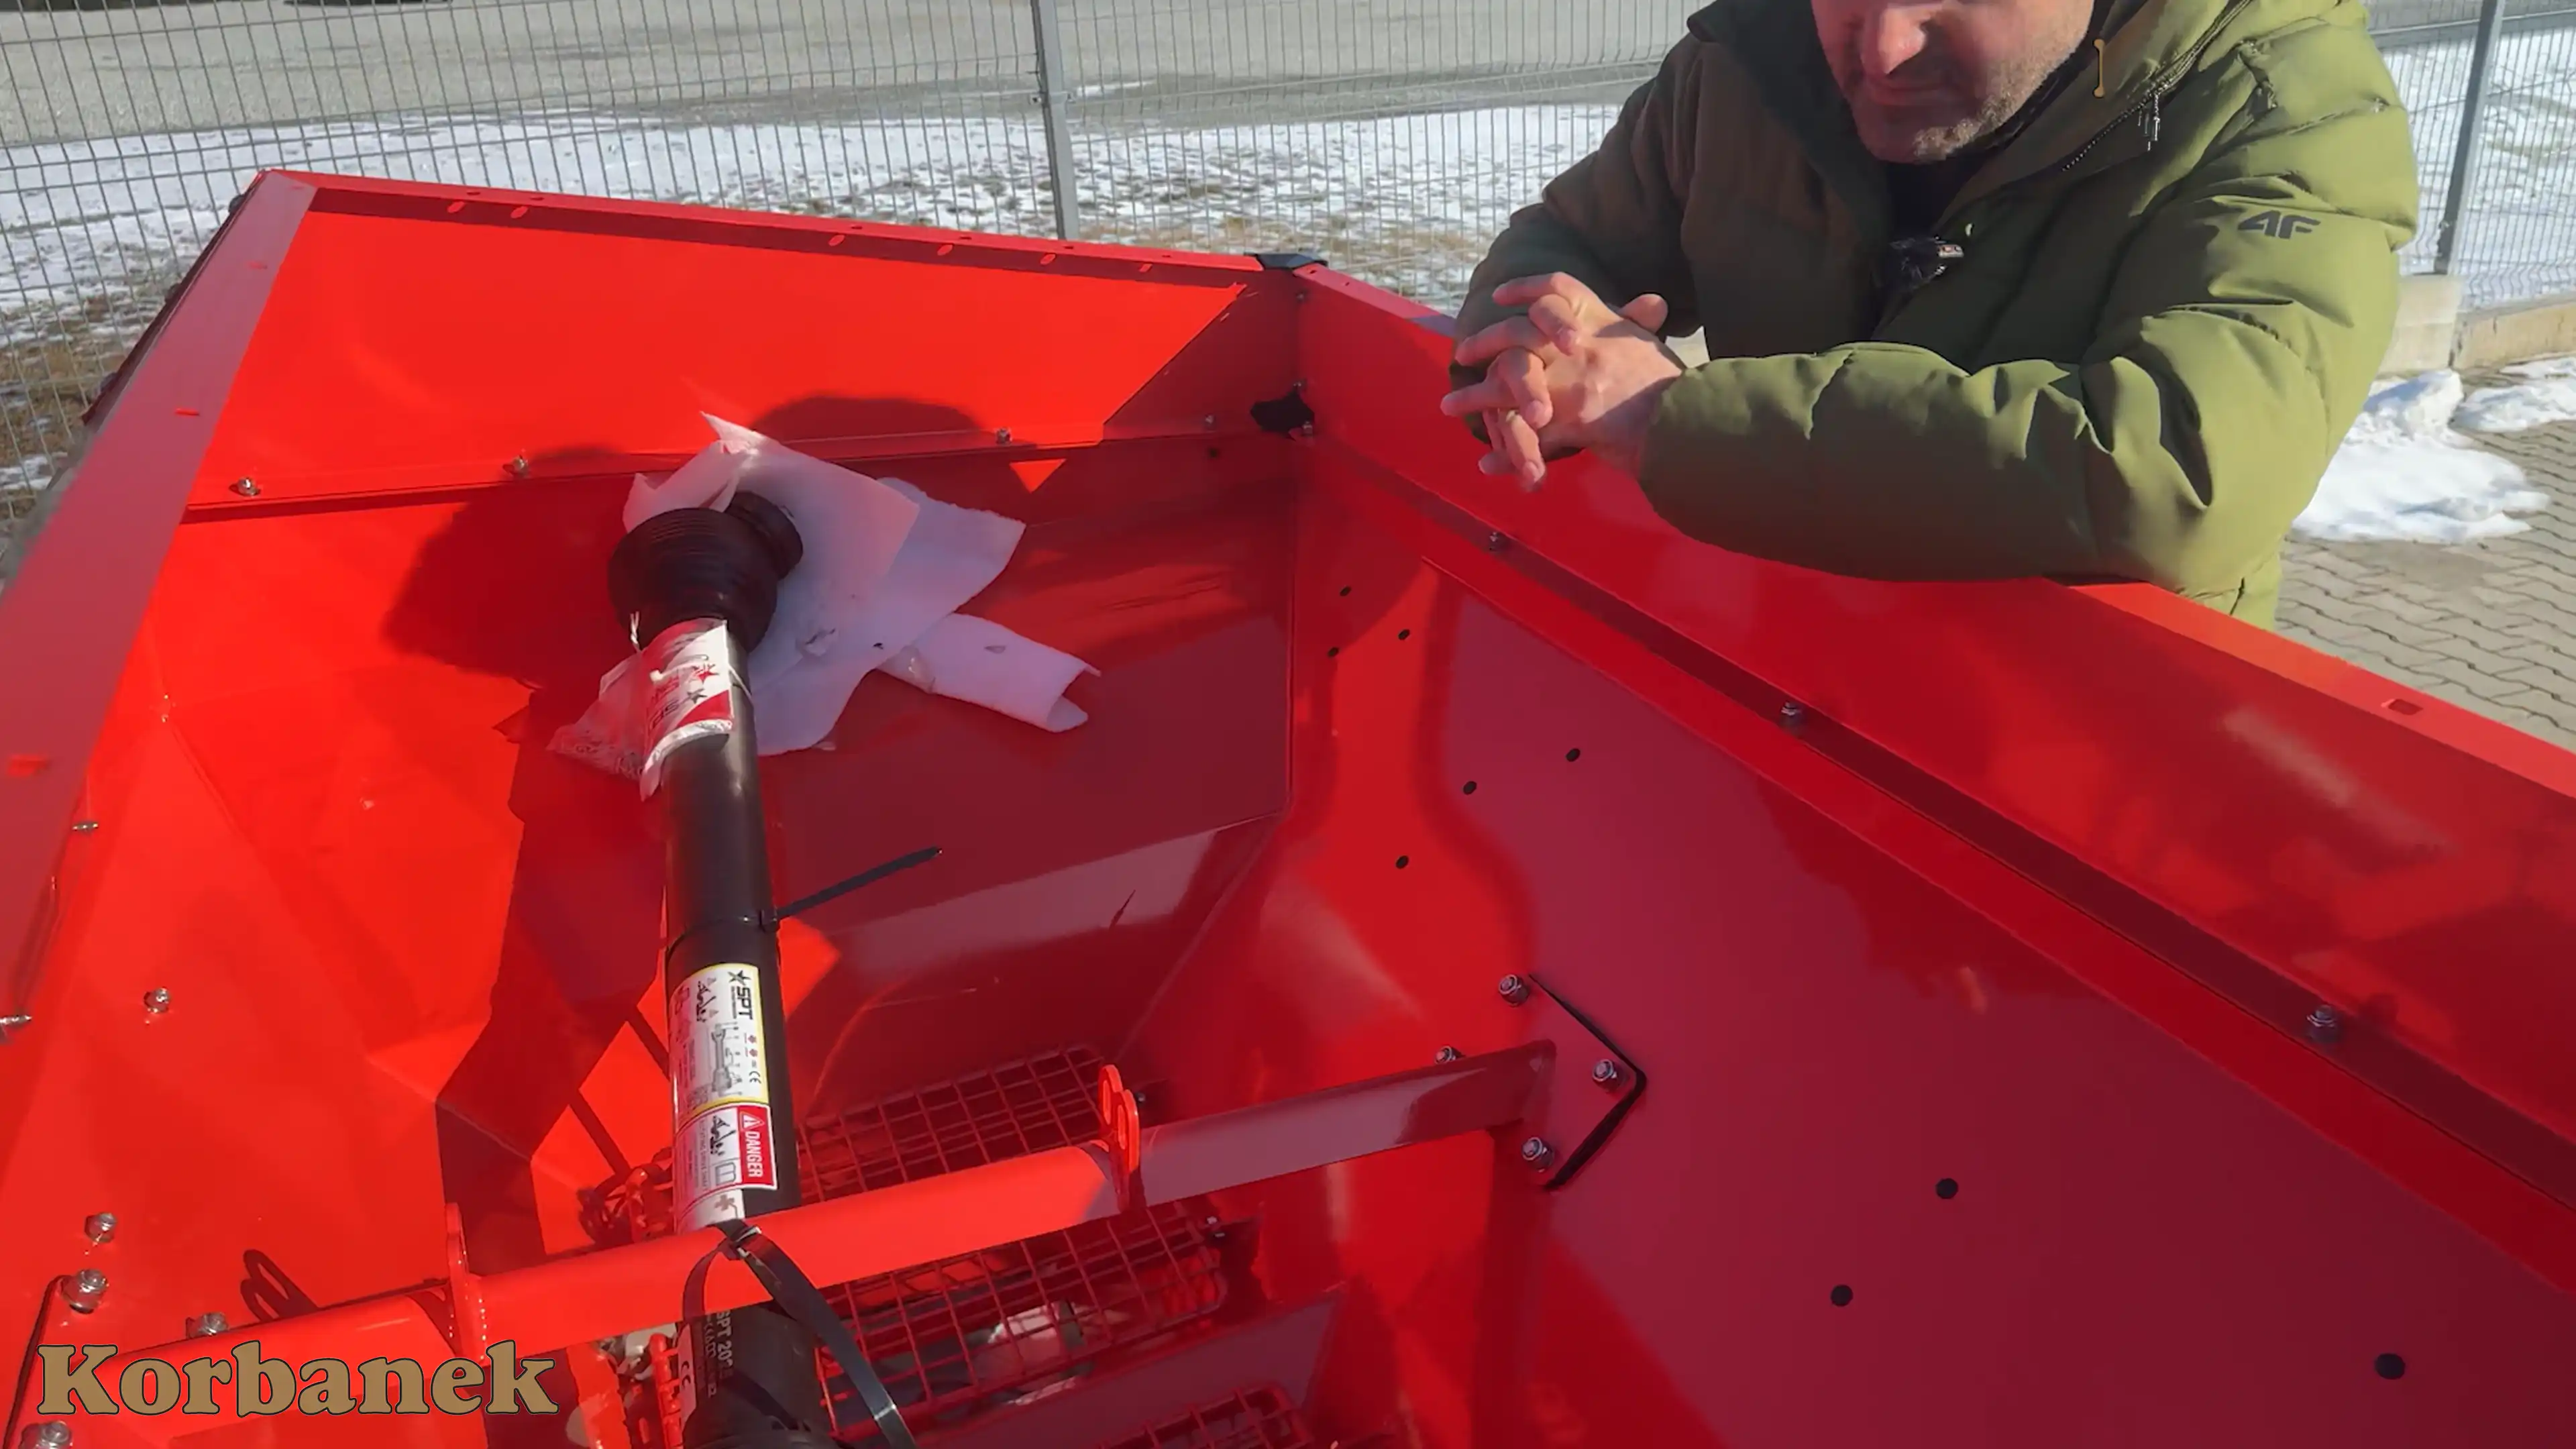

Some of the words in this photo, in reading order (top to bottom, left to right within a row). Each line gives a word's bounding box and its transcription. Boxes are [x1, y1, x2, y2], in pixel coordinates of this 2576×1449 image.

[2238, 210, 2321, 239] 4F
[737, 985, 753, 1020] SPT
[745, 1131, 763, 1177] DANGER
